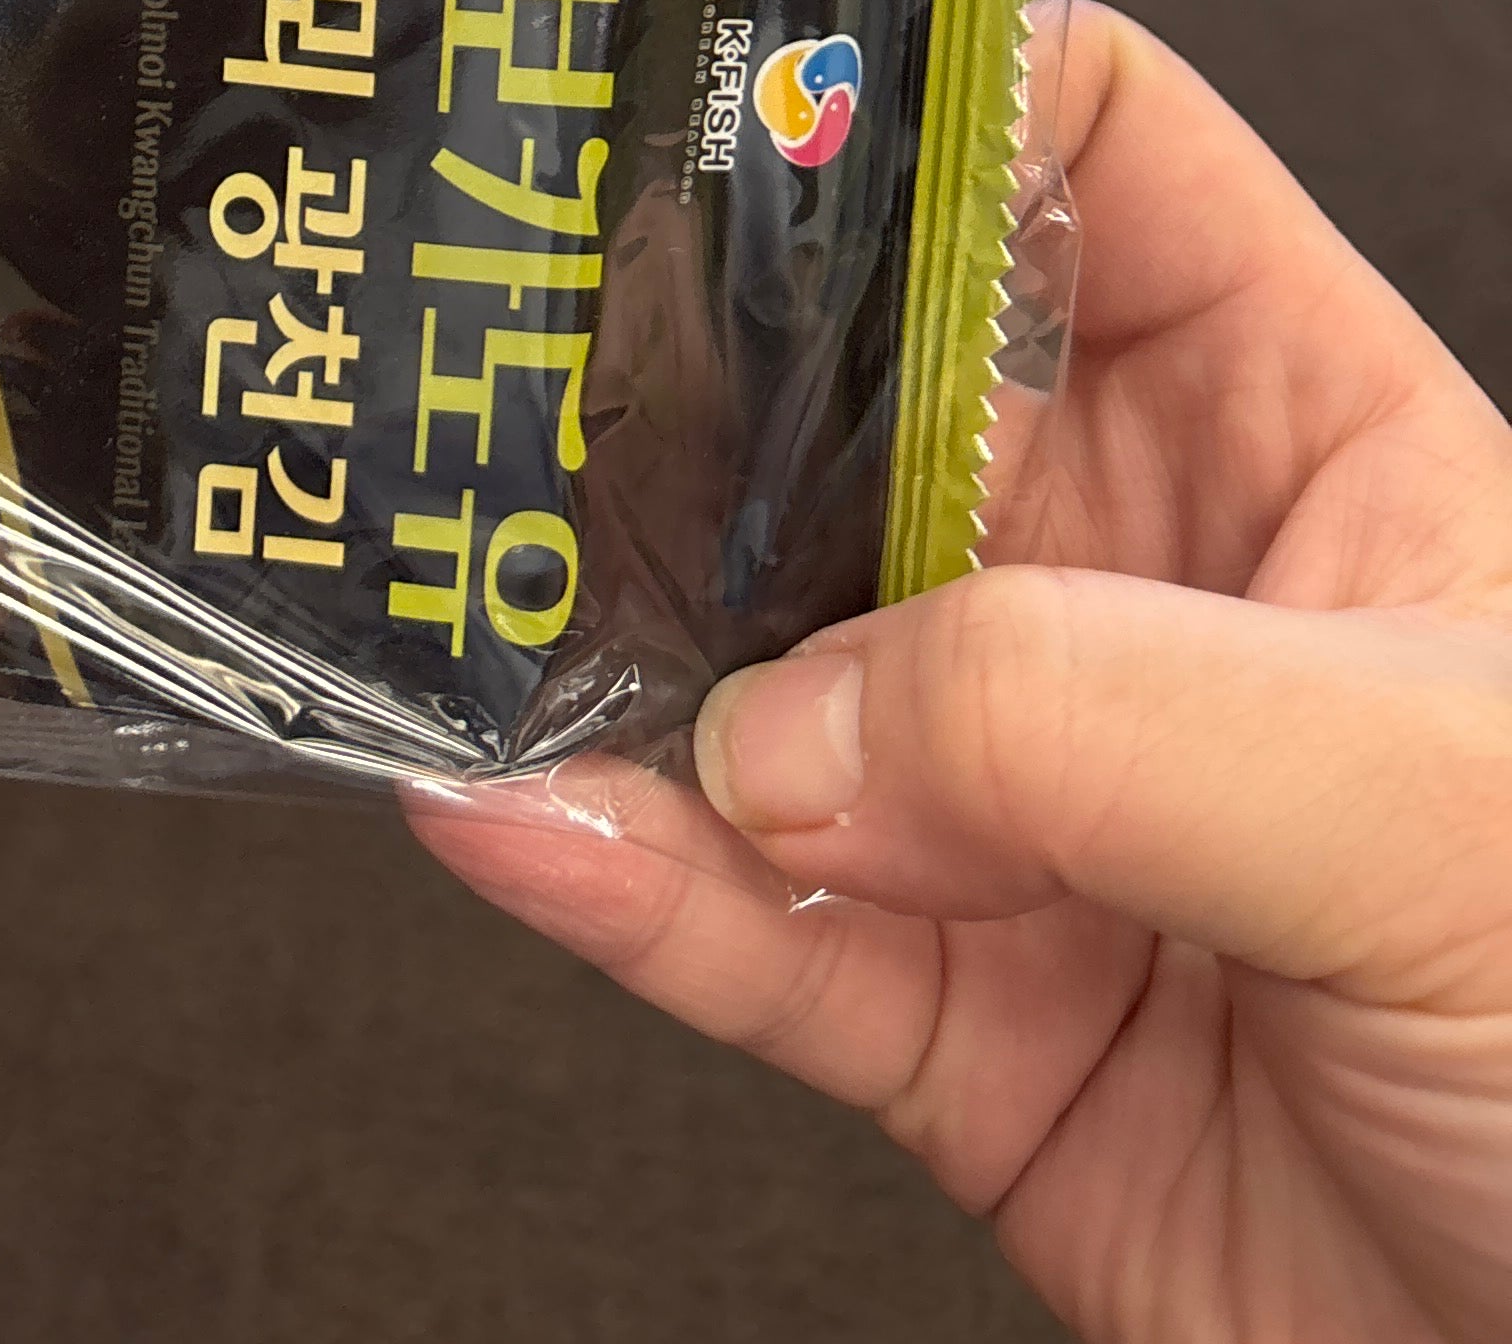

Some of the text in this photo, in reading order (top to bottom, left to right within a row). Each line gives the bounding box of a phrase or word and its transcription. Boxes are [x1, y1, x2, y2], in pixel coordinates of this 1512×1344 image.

[117, 99, 169, 309] Kwangchun
[111, 319, 161, 509] Traditional
[192, 145, 368, 568] 광천김
